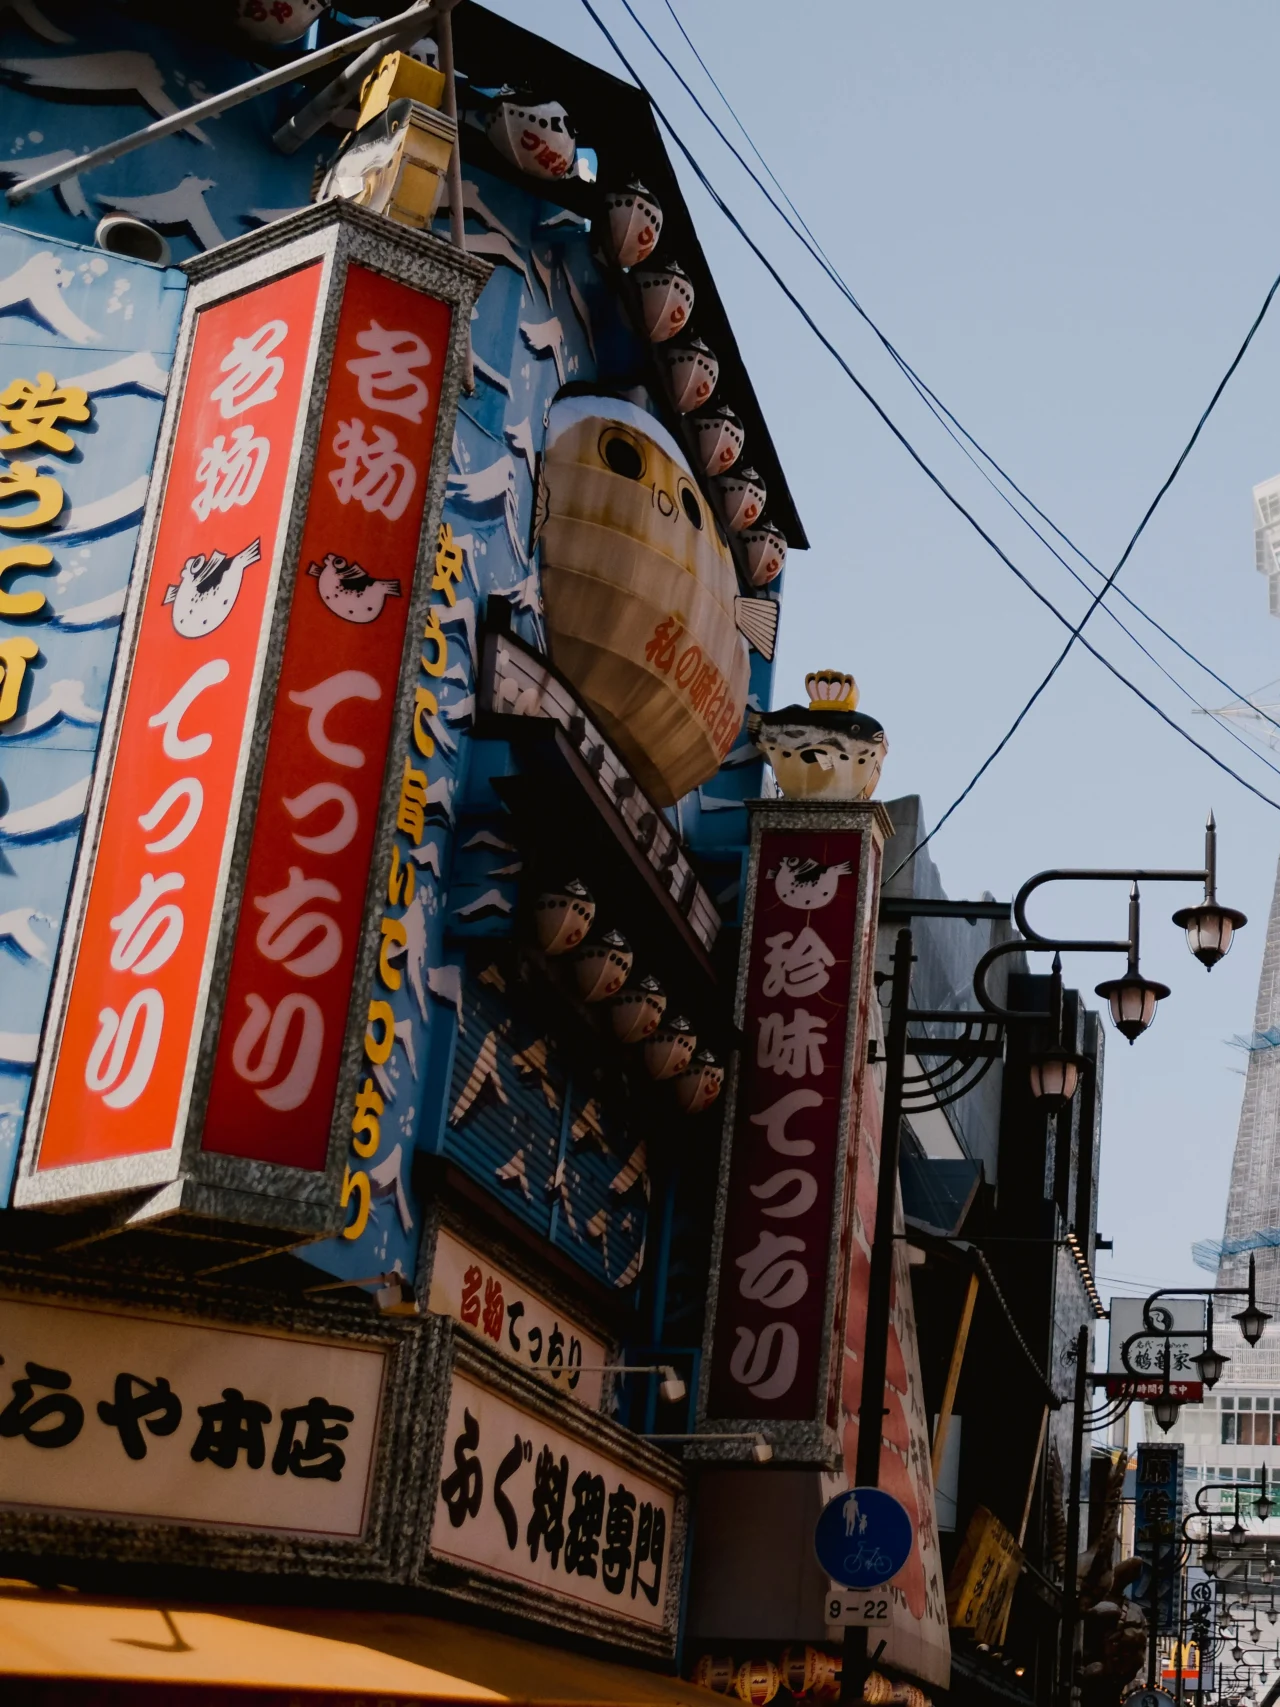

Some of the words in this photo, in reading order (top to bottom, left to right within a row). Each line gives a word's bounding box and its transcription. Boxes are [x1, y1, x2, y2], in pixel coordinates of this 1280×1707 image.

[191, 319, 289, 523] 名物
[331, 319, 432, 522] 名物
[84, 658, 230, 1110] てっちり
[232, 670, 381, 1112] てっちり
[440, 1406, 668, 1608] ふぐ料理専門
[829, 1598, 889, 1620] 9-22
